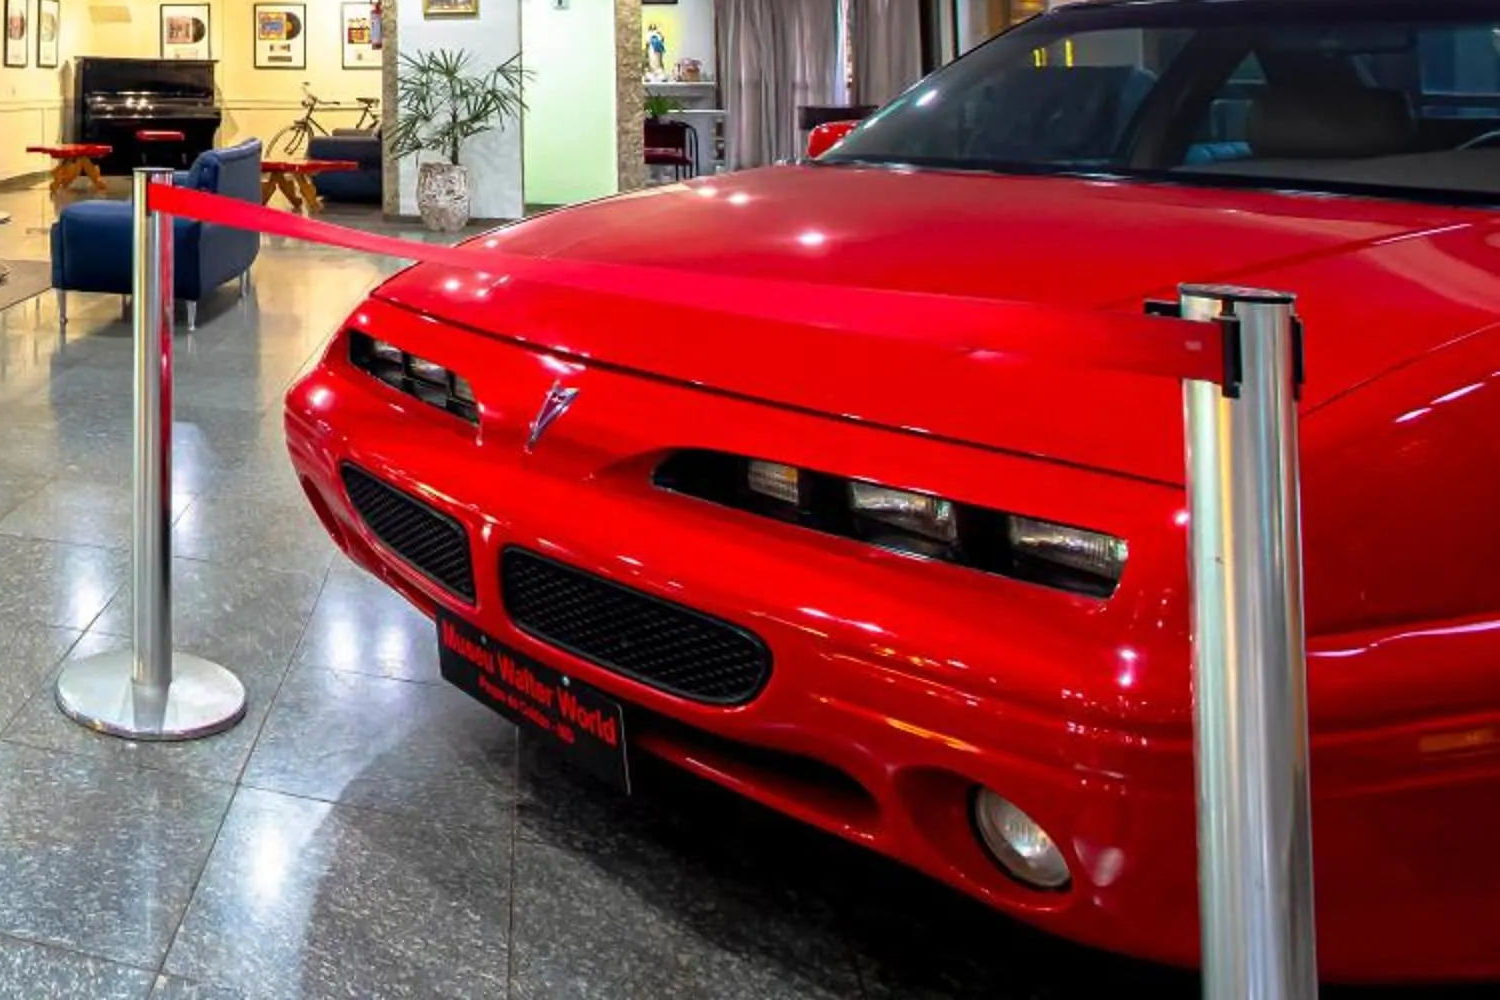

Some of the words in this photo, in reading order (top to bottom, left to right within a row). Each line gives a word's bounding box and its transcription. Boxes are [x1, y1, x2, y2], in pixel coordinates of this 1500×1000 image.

[442, 619, 495, 675] Museu
[498, 652, 553, 706] Walter
[557, 685, 617, 748] World
